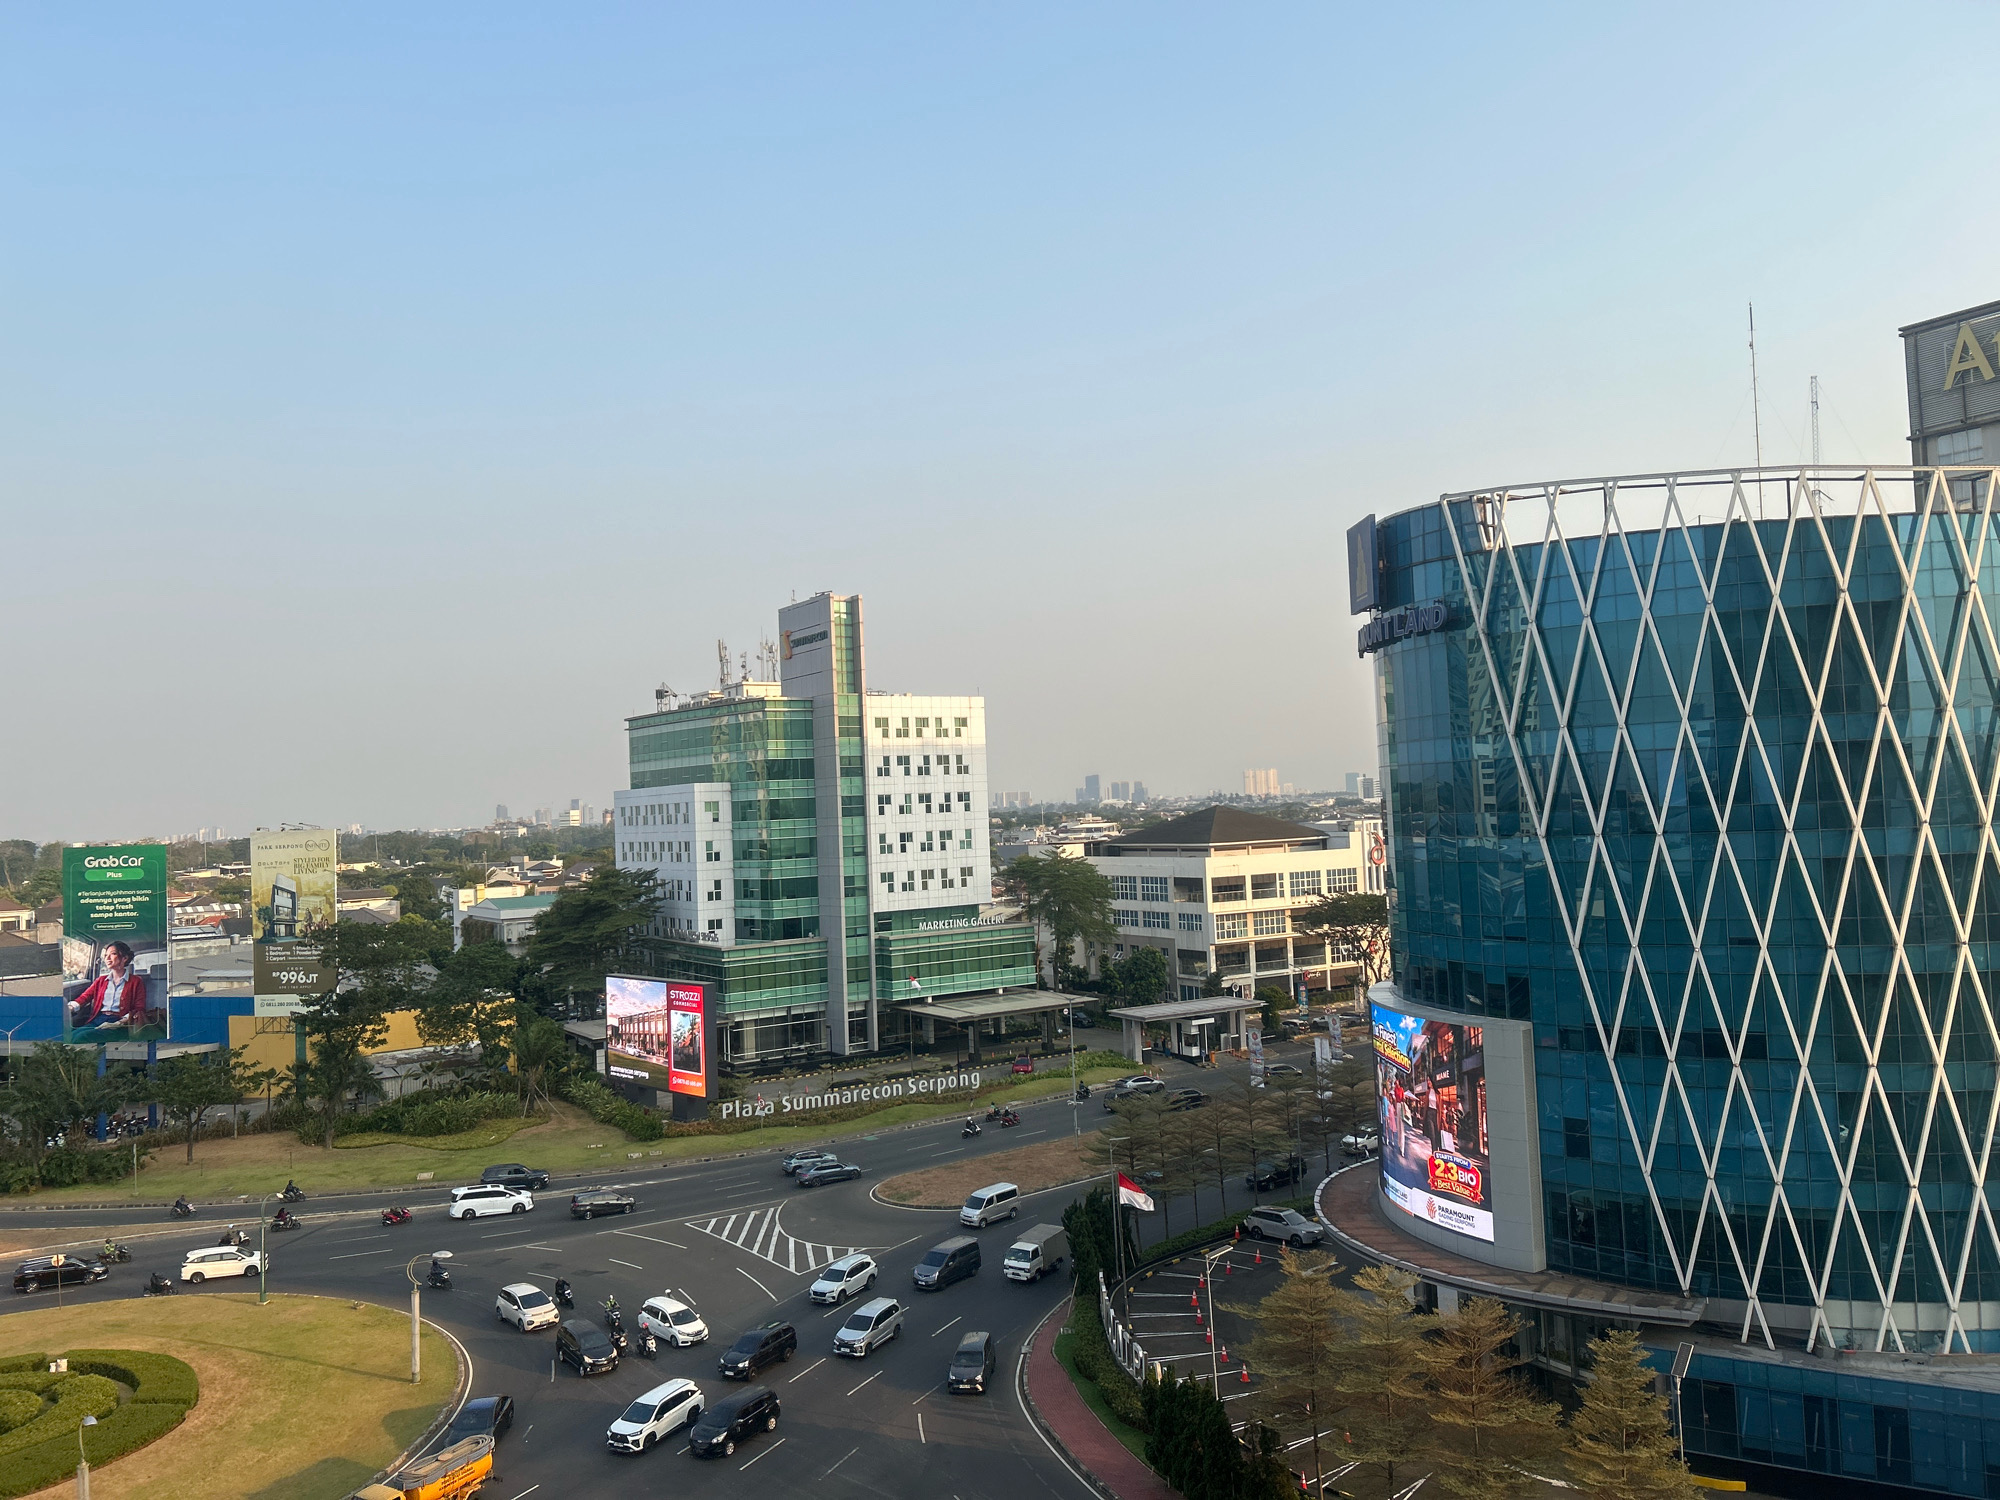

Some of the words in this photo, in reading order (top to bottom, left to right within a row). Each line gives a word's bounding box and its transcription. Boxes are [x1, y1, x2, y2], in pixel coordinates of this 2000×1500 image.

[1943, 322, 2000, 391] A
[1393, 604, 1447, 637] LAND
[919, 918, 968, 931] MARKETING
[971, 914, 1005, 927] GALLERY
[670, 990, 700, 1001] STROZZI
[782, 1083, 903, 1113] Summarecon
[908, 1072, 980, 1095] Serpong
[1435, 1152, 1453, 1161] STARTS
[1453, 1157, 1469, 1167] FROM
[1434, 1158, 1458, 1181] 2.3
[1437, 1180, 1451, 1190] Best
[1451, 1182, 1471, 1195] Value
[1438, 1205, 1475, 1222] PARAMOUNT
